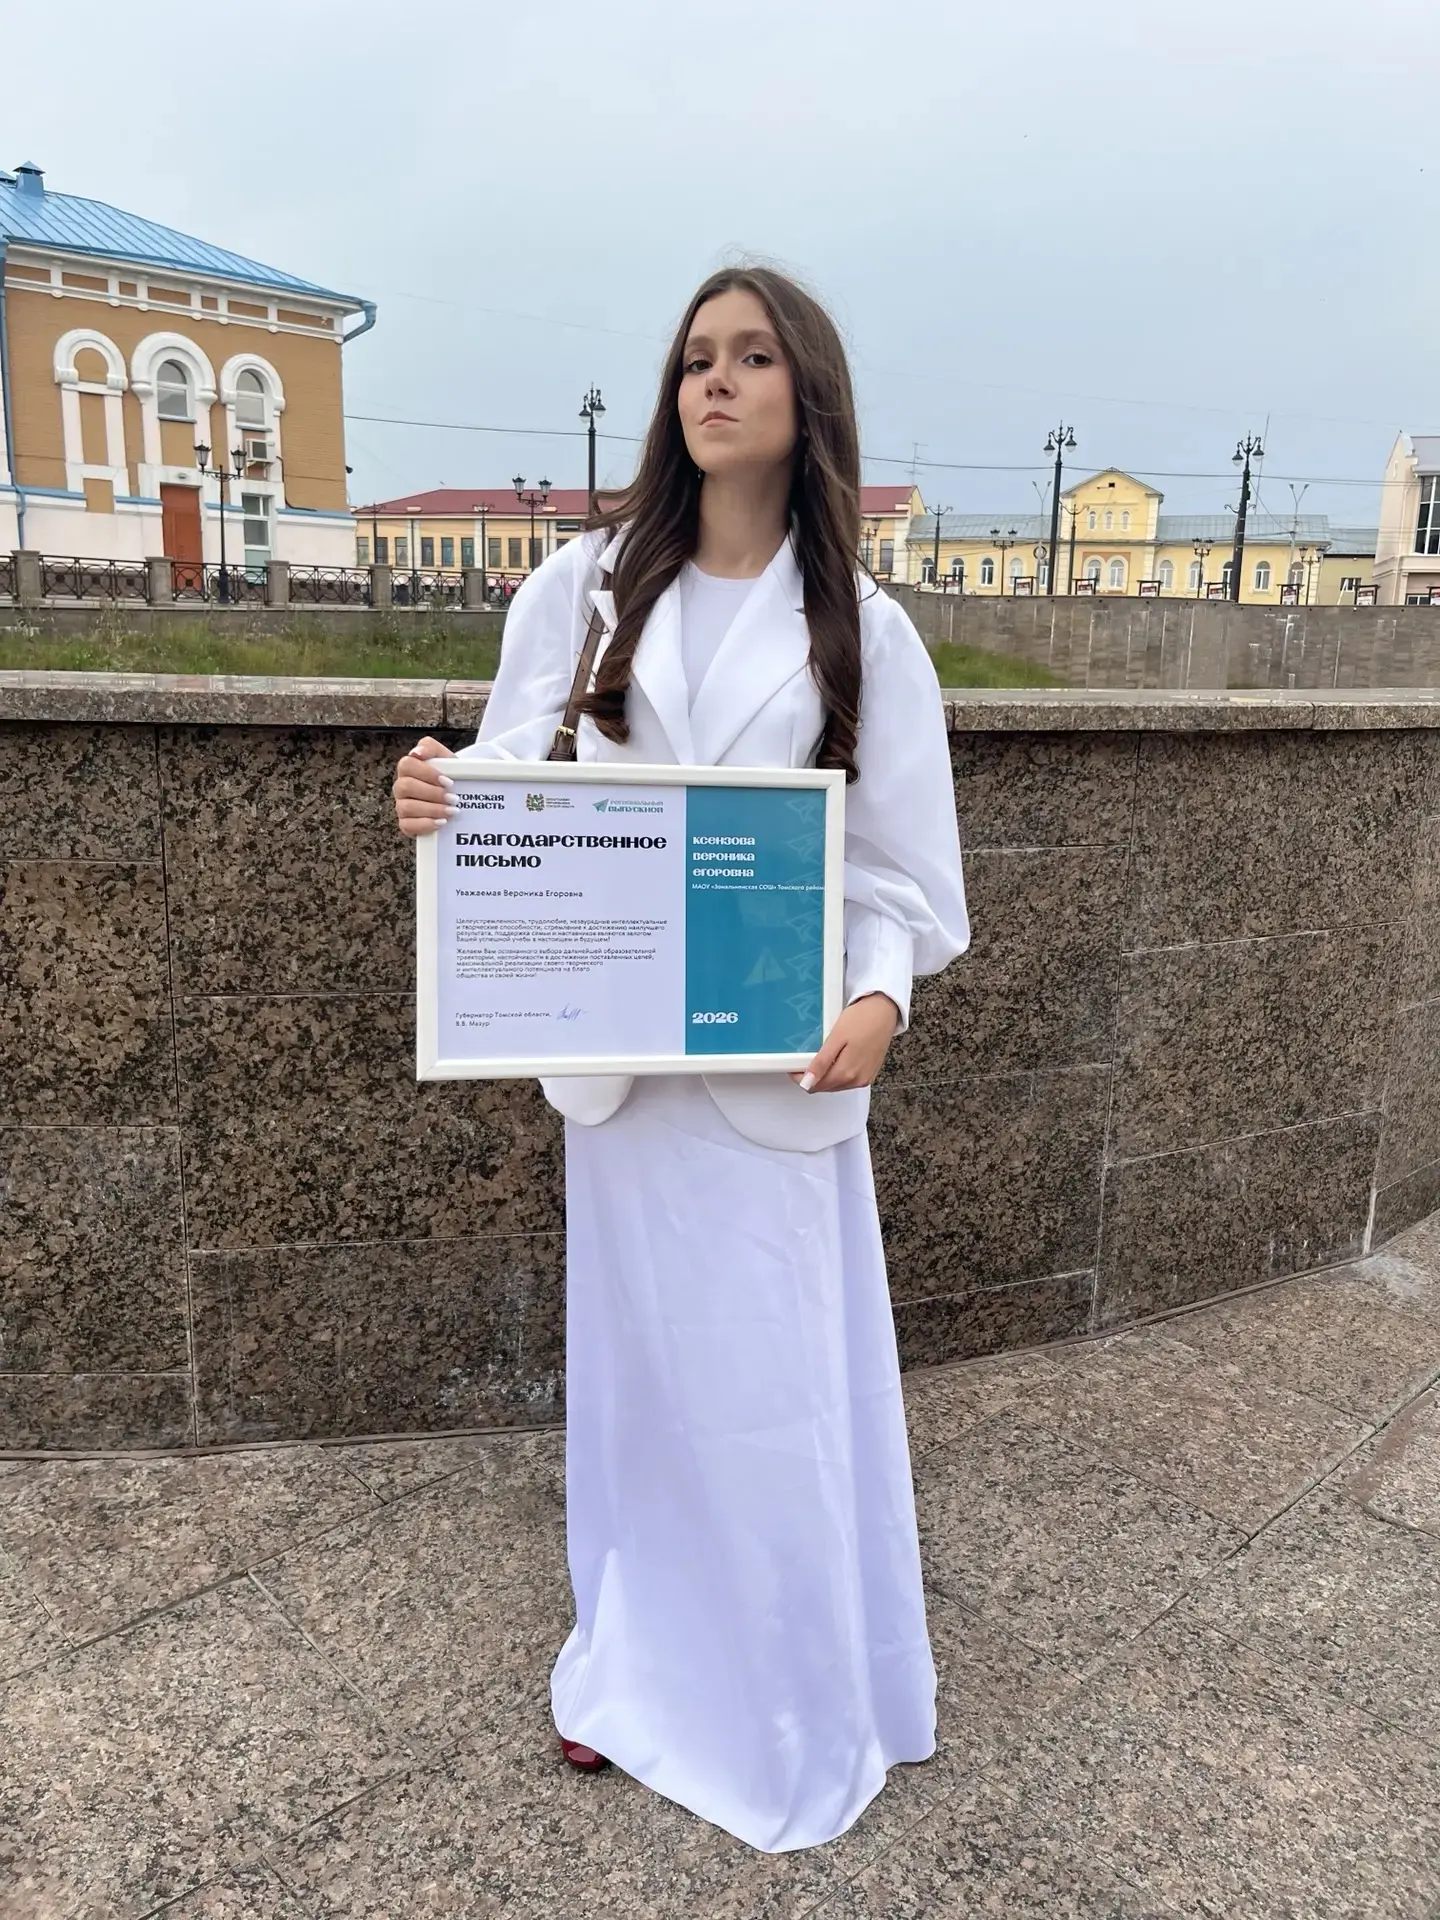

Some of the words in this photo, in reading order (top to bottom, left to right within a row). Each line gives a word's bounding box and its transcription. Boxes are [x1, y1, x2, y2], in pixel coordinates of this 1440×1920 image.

[456, 832, 667, 849] БЛАГОДАРСТВЕННОЕ
[692, 836, 756, 846] КСЕНЗОВА
[456, 854, 542, 868] ПИСЬМО
[692, 852, 755, 861] ВЕРОНИКА
[692, 868, 754, 877] ЕГОРОВНА
[456, 889, 501, 897] Уважаемая
[504, 890, 543, 898] Вероника
[546, 890, 583, 898] Егоровна
[692, 1012, 739, 1024] 2026
